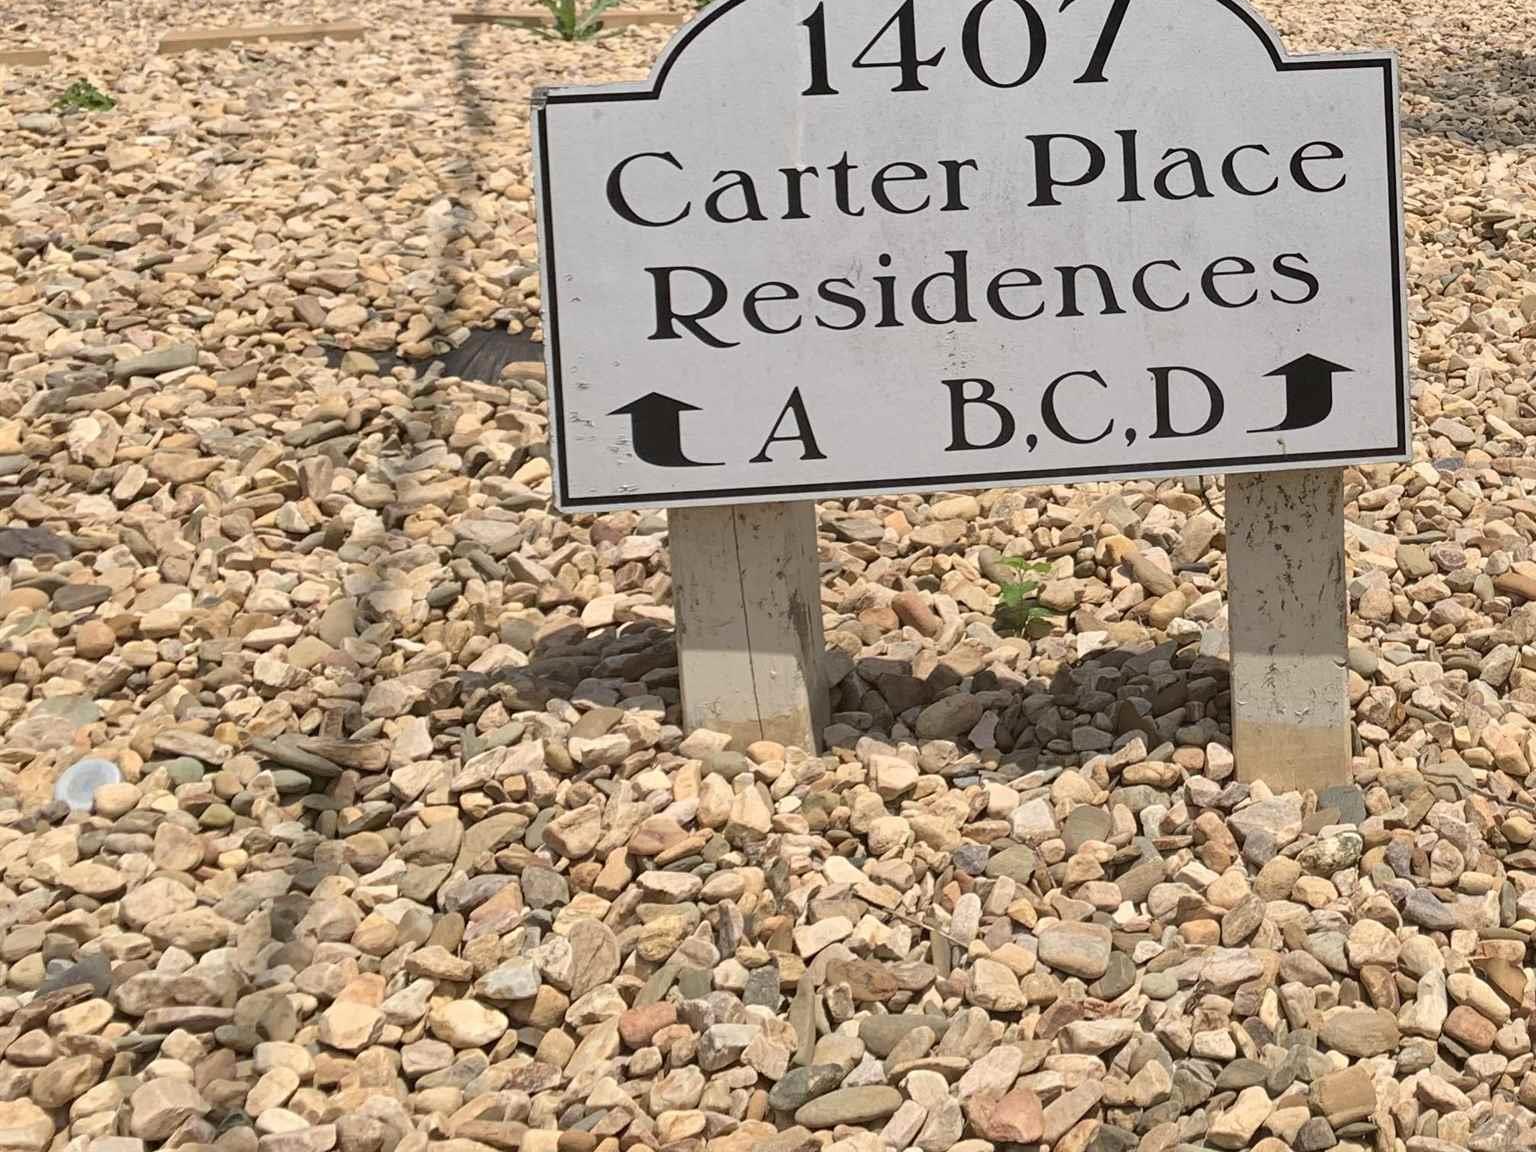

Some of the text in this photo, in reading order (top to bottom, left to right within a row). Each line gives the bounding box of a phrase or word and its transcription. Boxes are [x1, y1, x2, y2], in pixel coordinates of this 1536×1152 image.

[606, 129, 1347, 227] Carter Place
[645, 249, 1320, 349] Residences
[748, 366, 1225, 464] A B,C,D
